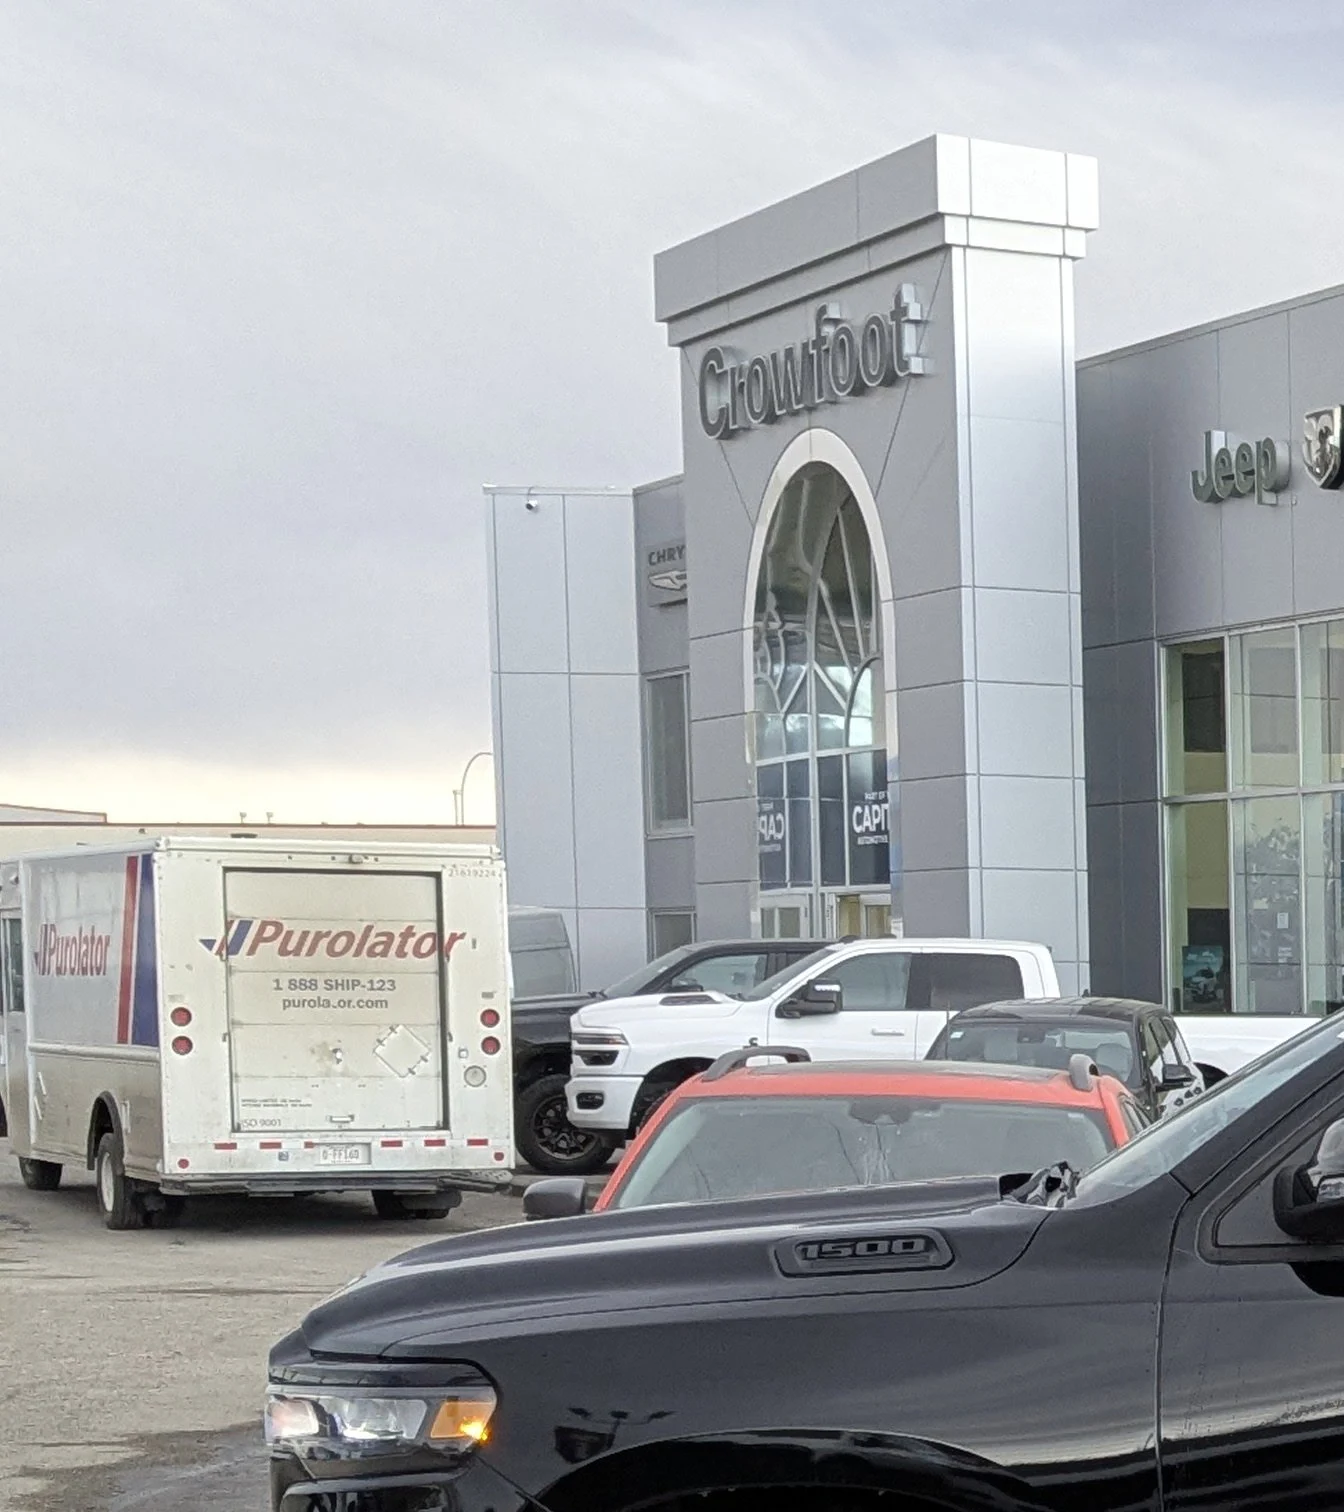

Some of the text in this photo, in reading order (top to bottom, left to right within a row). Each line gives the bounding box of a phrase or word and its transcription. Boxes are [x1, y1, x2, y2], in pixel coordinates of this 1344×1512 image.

[698, 283, 928, 441] Crowfoot
[1190, 430, 1288, 506] Jeep
[46, 924, 111, 977] Purolator
[246, 920, 467, 961] Purolator
[273, 979, 397, 992] 1 888 SHIP-123
[282, 996, 389, 1011] purolaor.com
[799, 1237, 926, 1259] 1500
